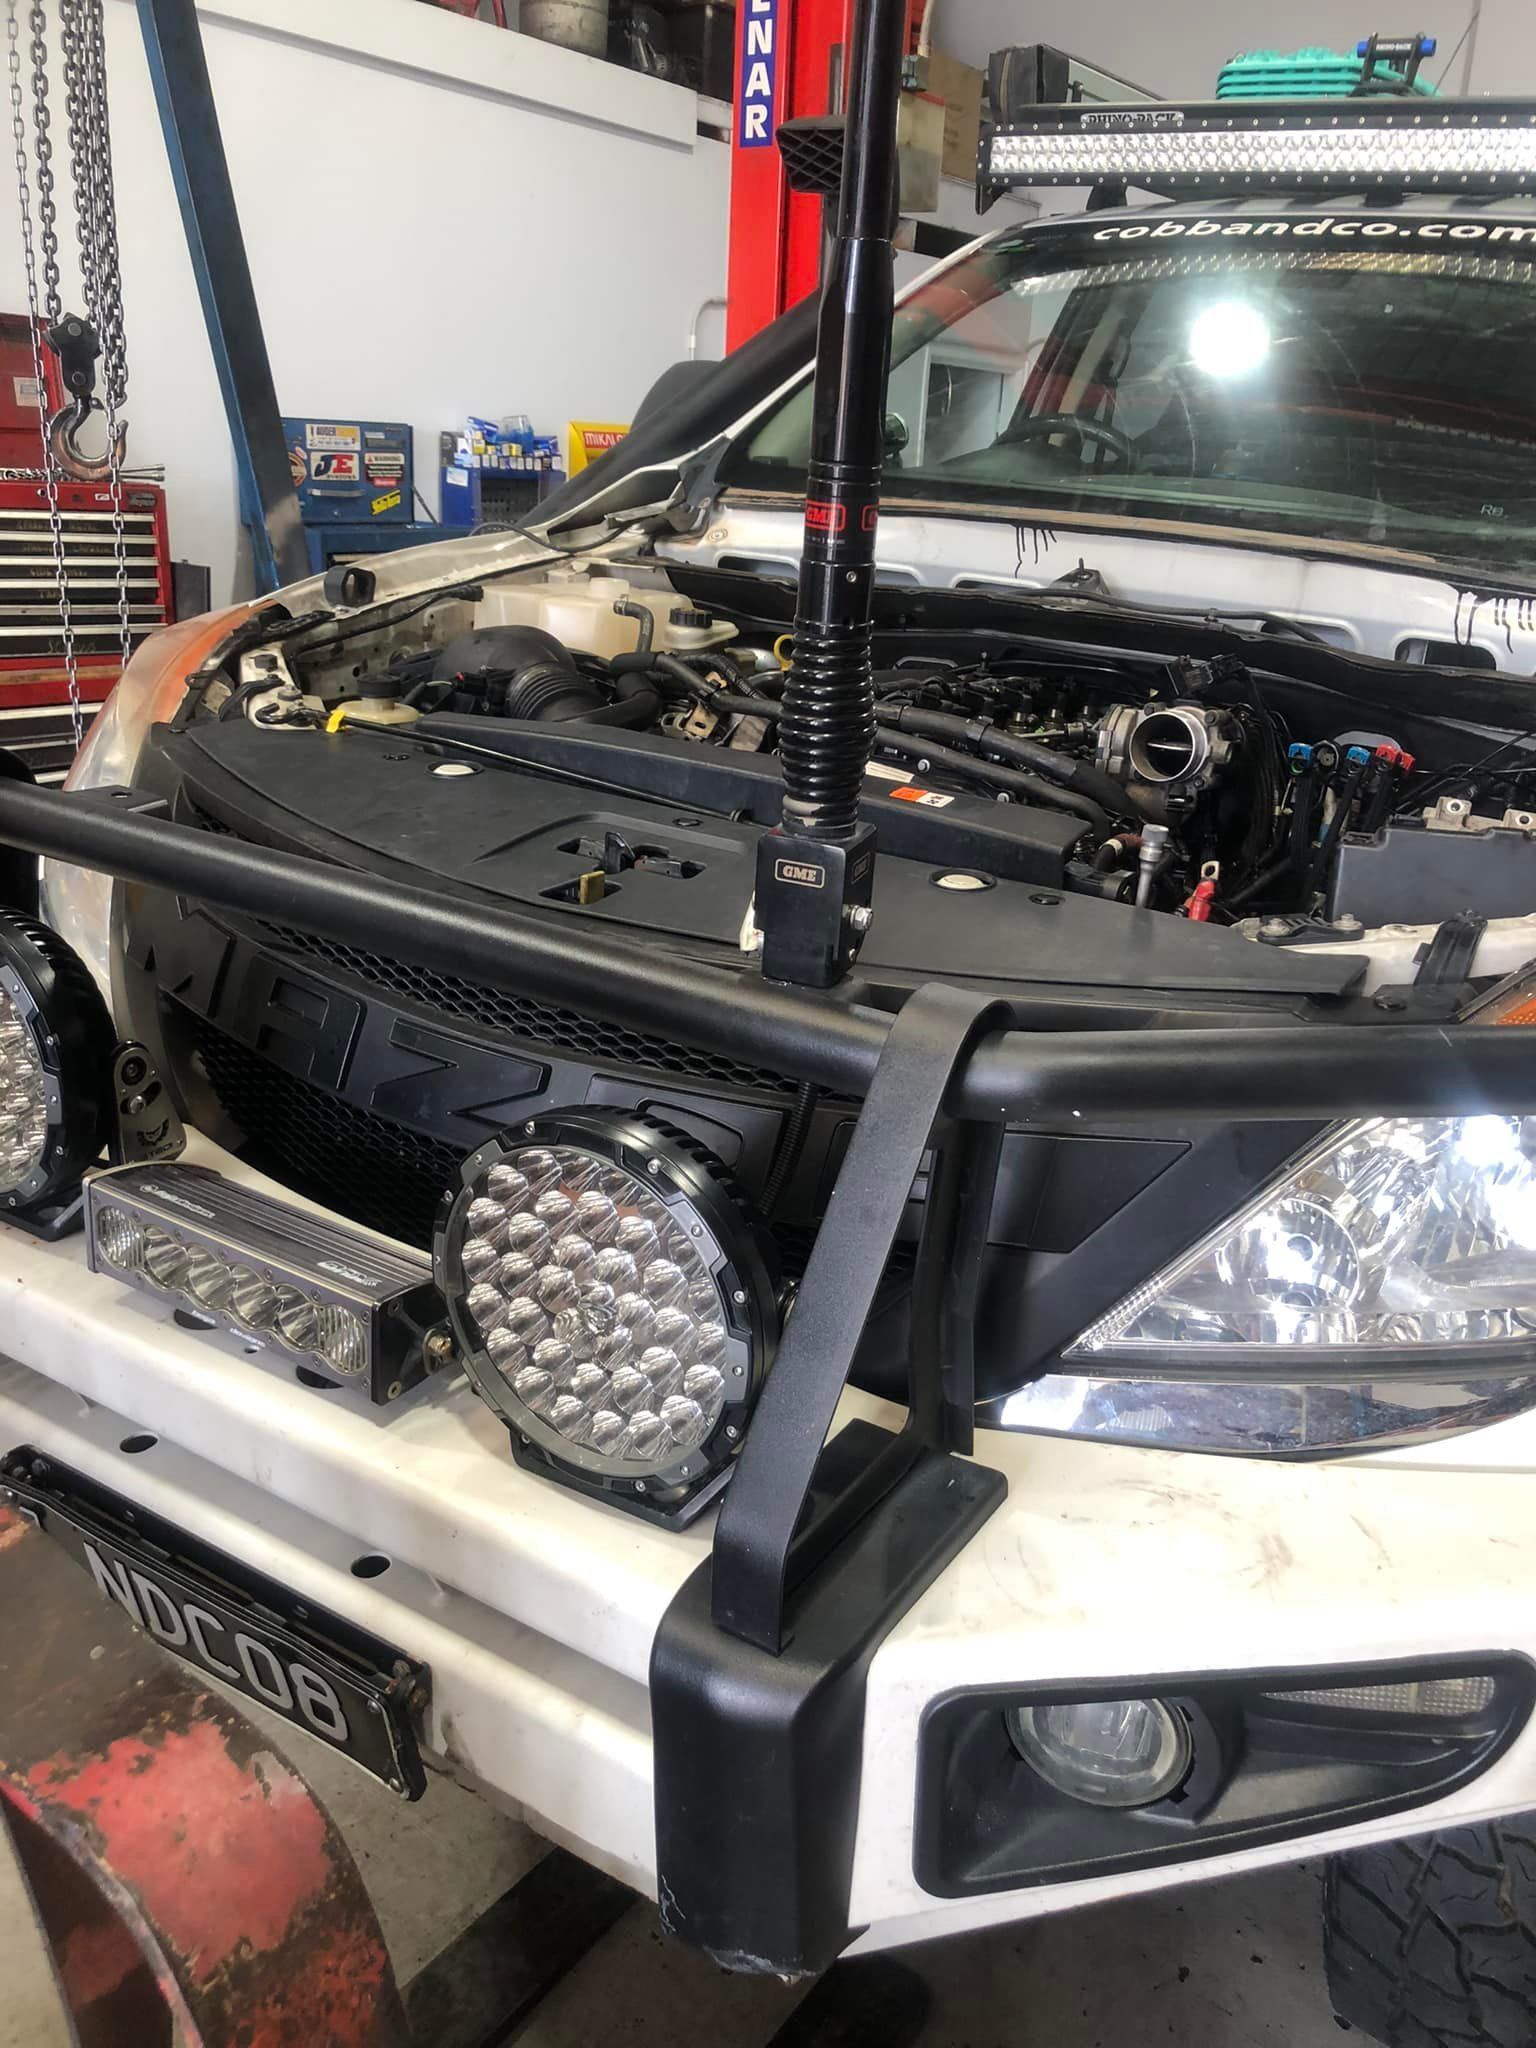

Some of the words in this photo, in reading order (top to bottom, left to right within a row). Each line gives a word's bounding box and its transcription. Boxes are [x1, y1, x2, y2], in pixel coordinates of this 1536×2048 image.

[1093, 218, 1536, 241] cobbandco.com
[314, 454, 354, 477] JE
[783, 865, 817, 883] GME
